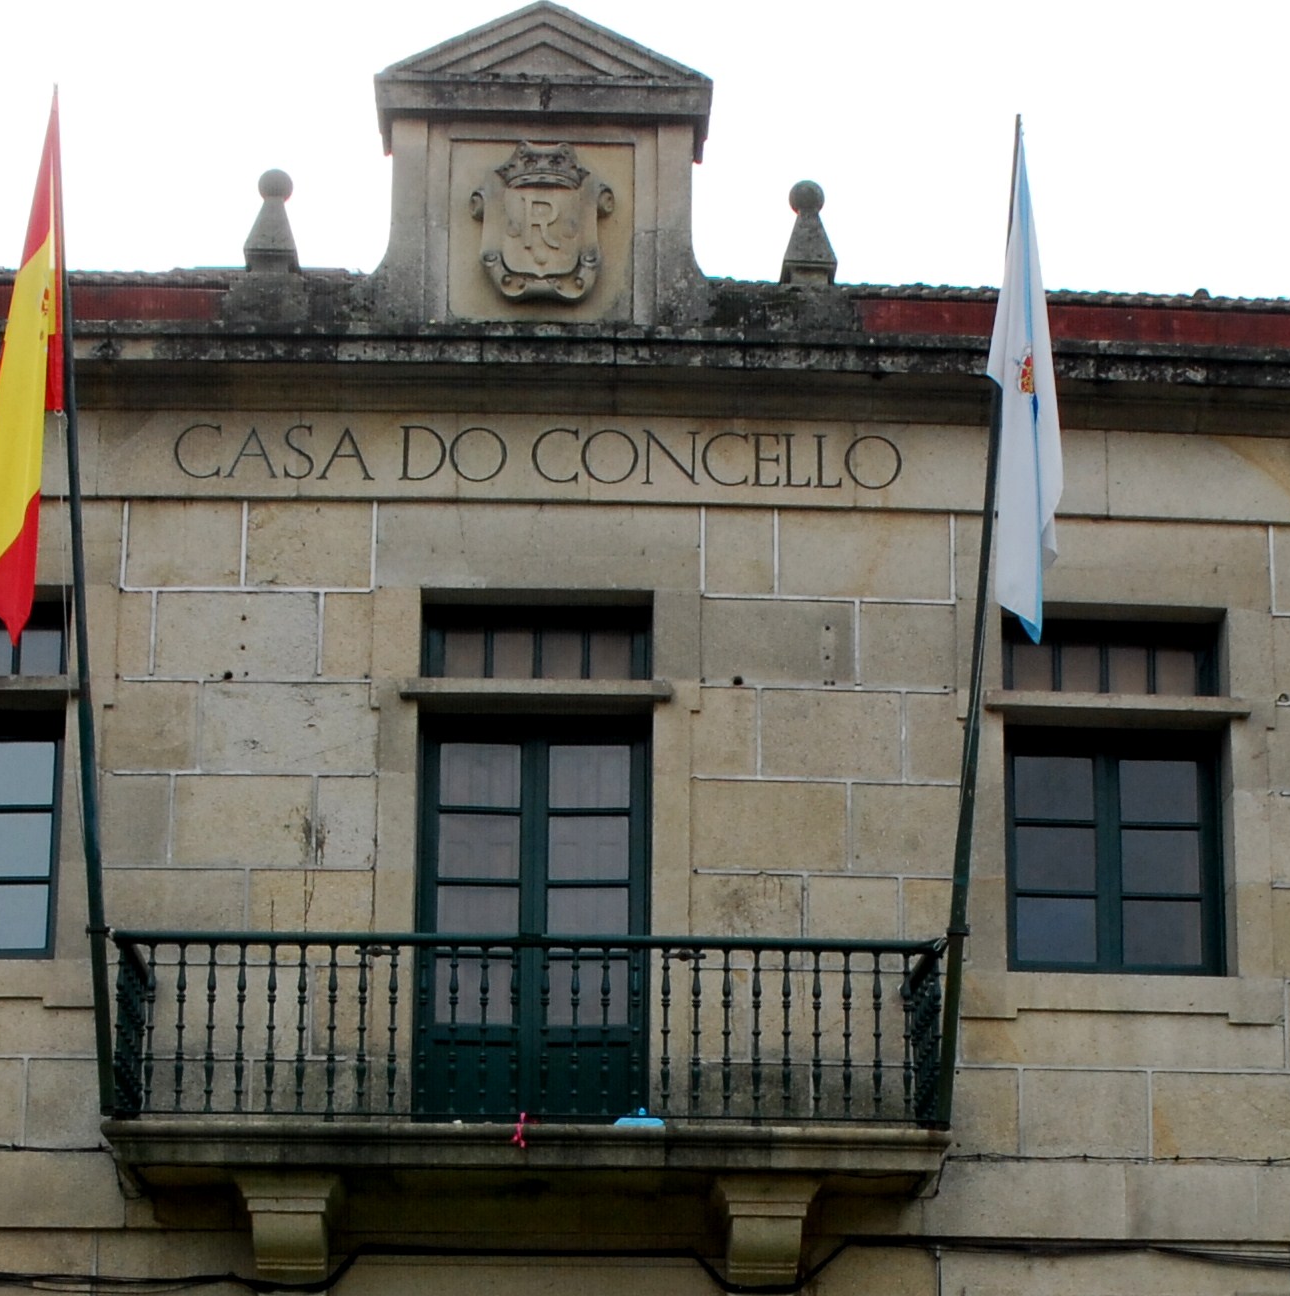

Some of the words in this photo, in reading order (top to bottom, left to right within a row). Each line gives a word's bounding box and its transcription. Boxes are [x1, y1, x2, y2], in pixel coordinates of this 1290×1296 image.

[174, 423, 376, 480] CASA
[399, 425, 507, 482] DO
[531, 428, 902, 489] CONCELLO
